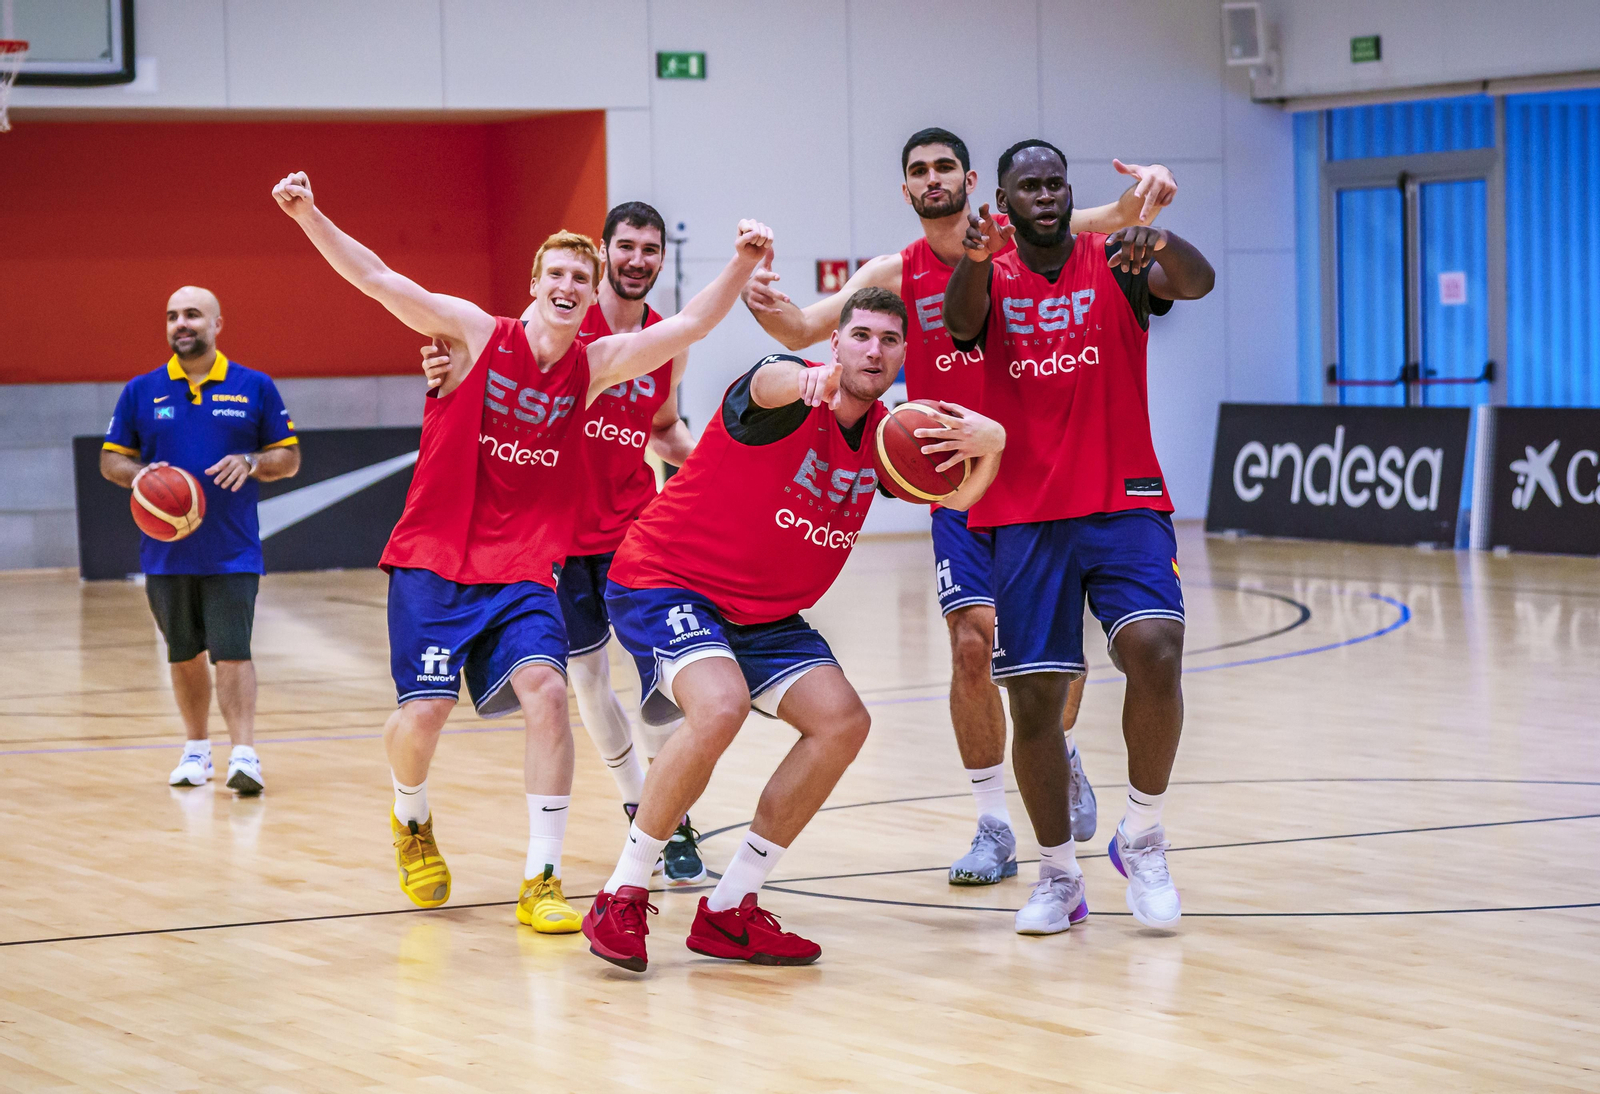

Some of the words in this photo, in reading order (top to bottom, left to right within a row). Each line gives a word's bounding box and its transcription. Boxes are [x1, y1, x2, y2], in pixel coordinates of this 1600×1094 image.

[1002, 288, 1096, 335] ESP
[935, 343, 984, 372] end
[211, 408, 246, 418] endesa
[483, 368, 576, 428] ESP
[584, 416, 647, 448] desa
[793, 447, 879, 504] ESP
[1233, 425, 1444, 511] endesa
[1566, 449, 1600, 506] C
[669, 627, 712, 646] network
[416, 674, 456, 683] network
